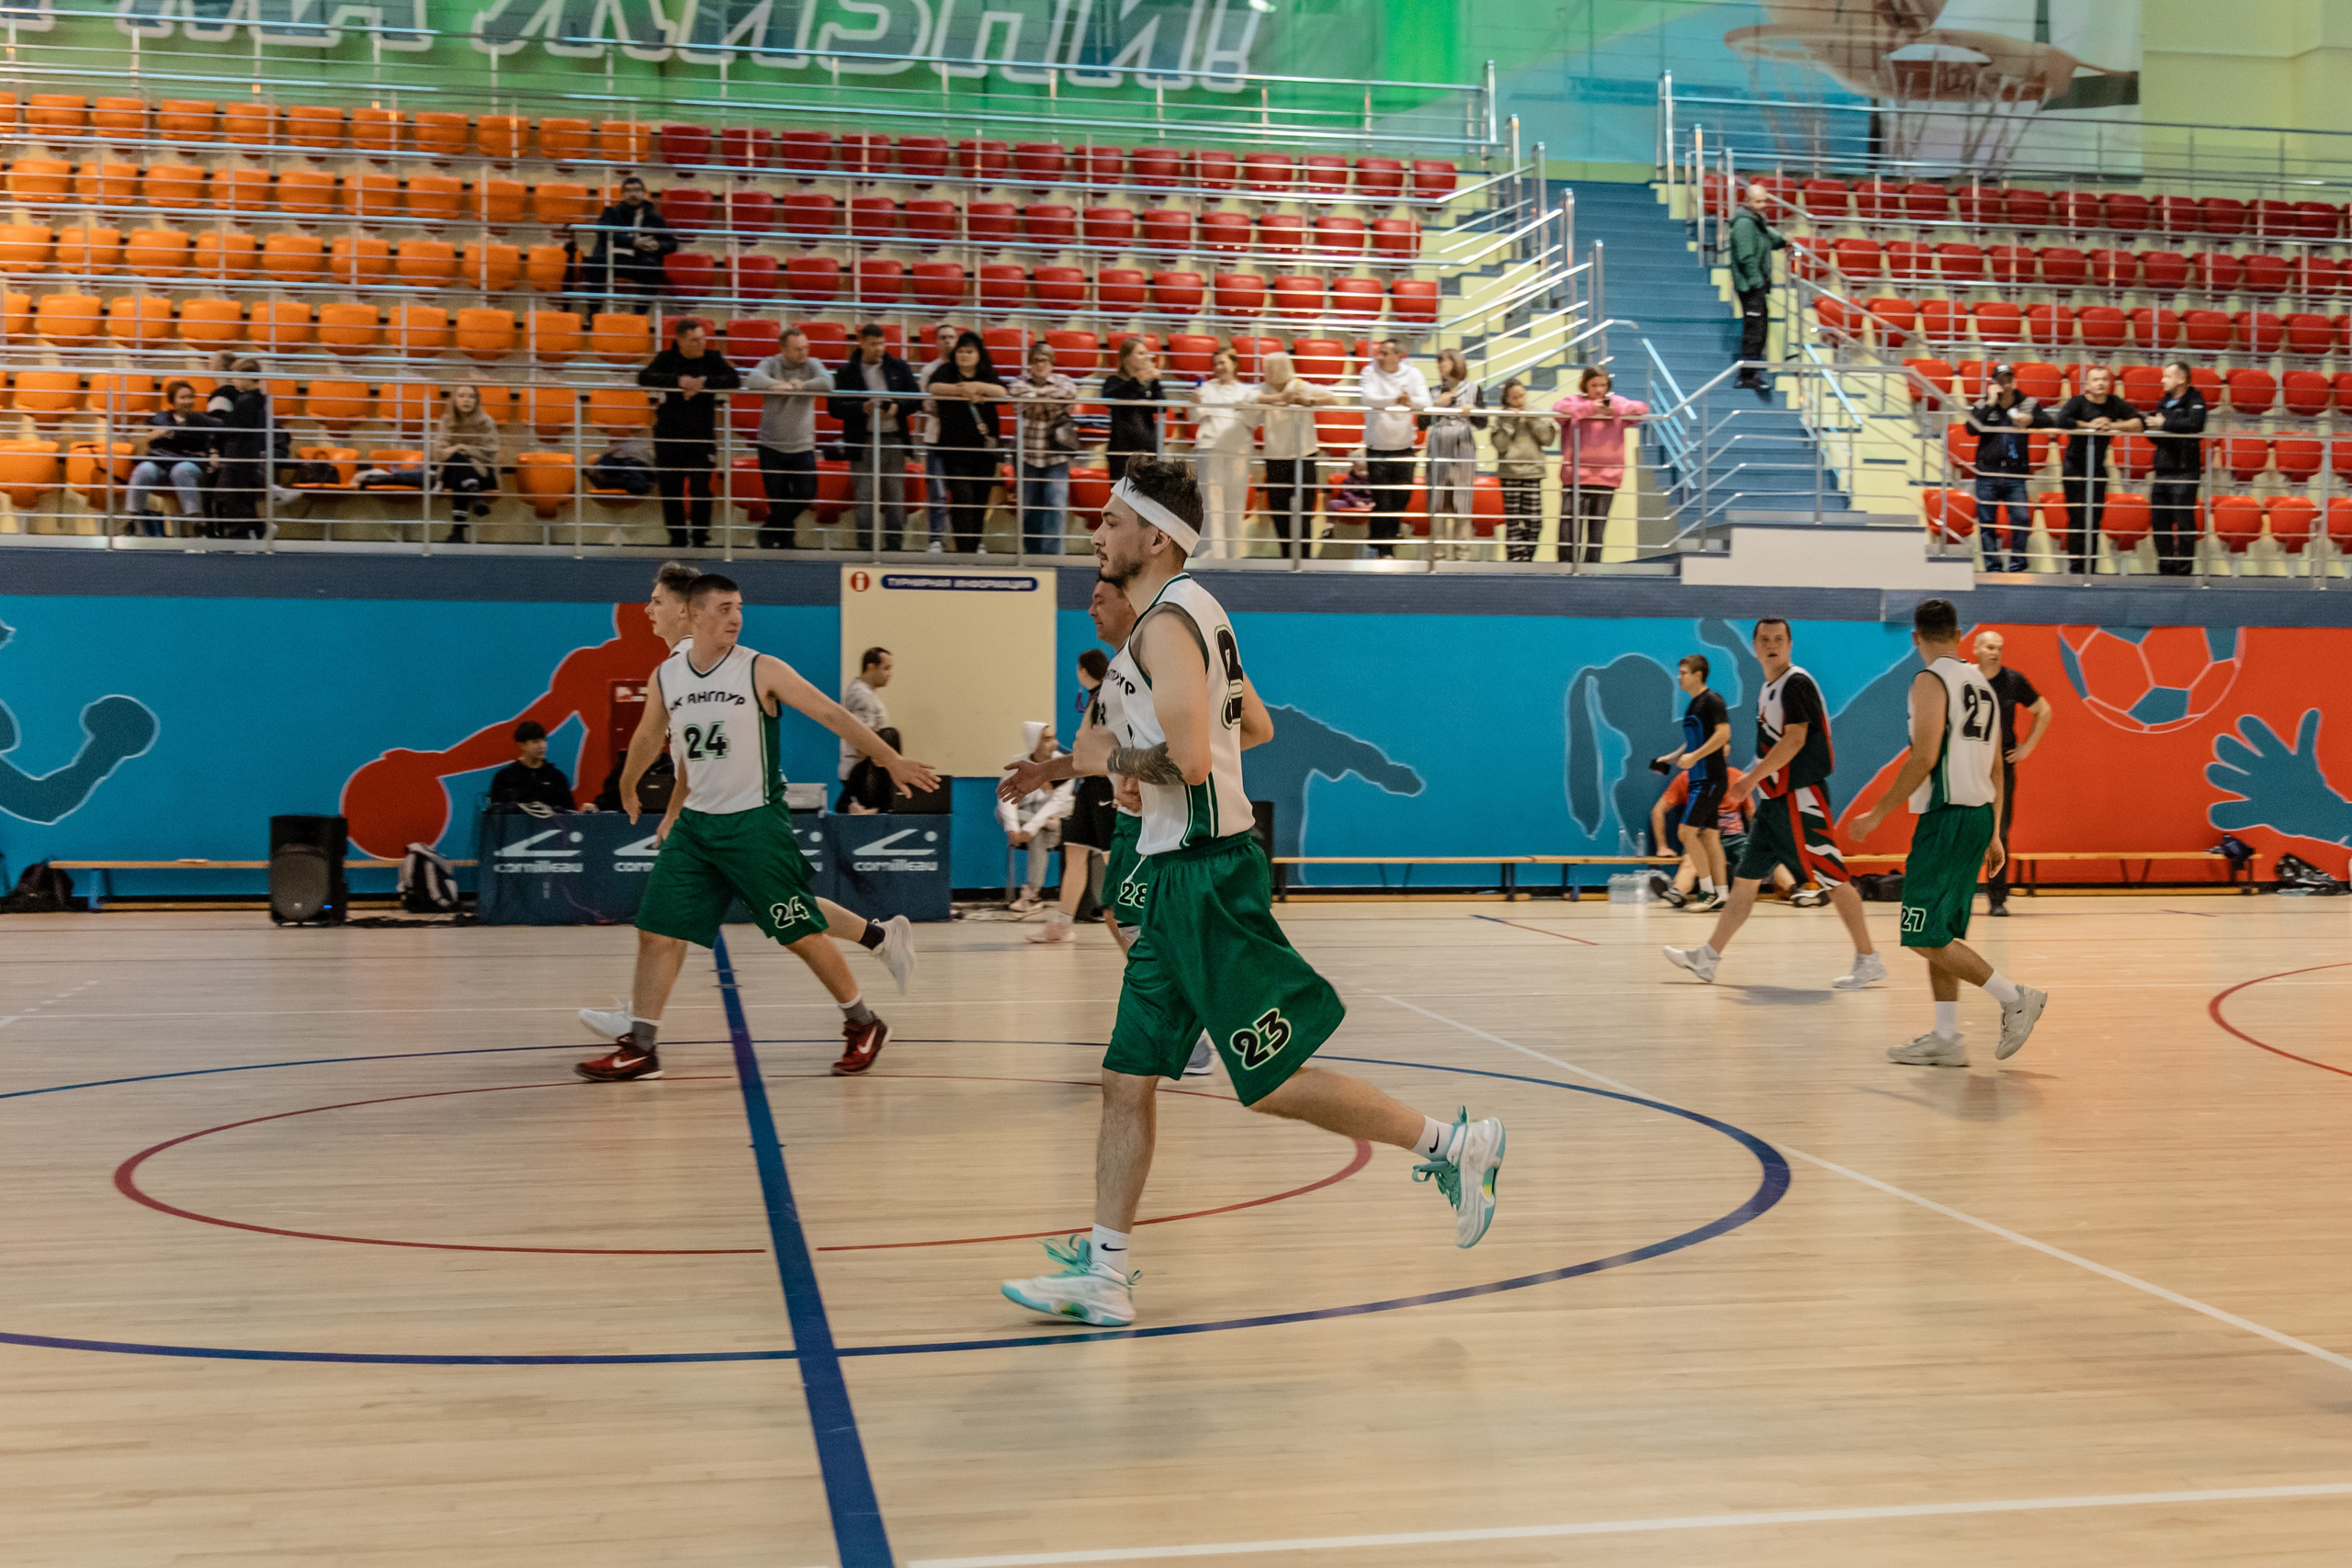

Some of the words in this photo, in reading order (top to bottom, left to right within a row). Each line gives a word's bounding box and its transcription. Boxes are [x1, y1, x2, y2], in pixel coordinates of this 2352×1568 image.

[1962, 682, 1995, 744] 27
[684, 721, 729, 761] 24
[853, 859, 938, 872] cornilleau
[770, 896, 810, 929] 24
[1901, 906, 1927, 931] 27
[1229, 1007, 1292, 1070] 23
